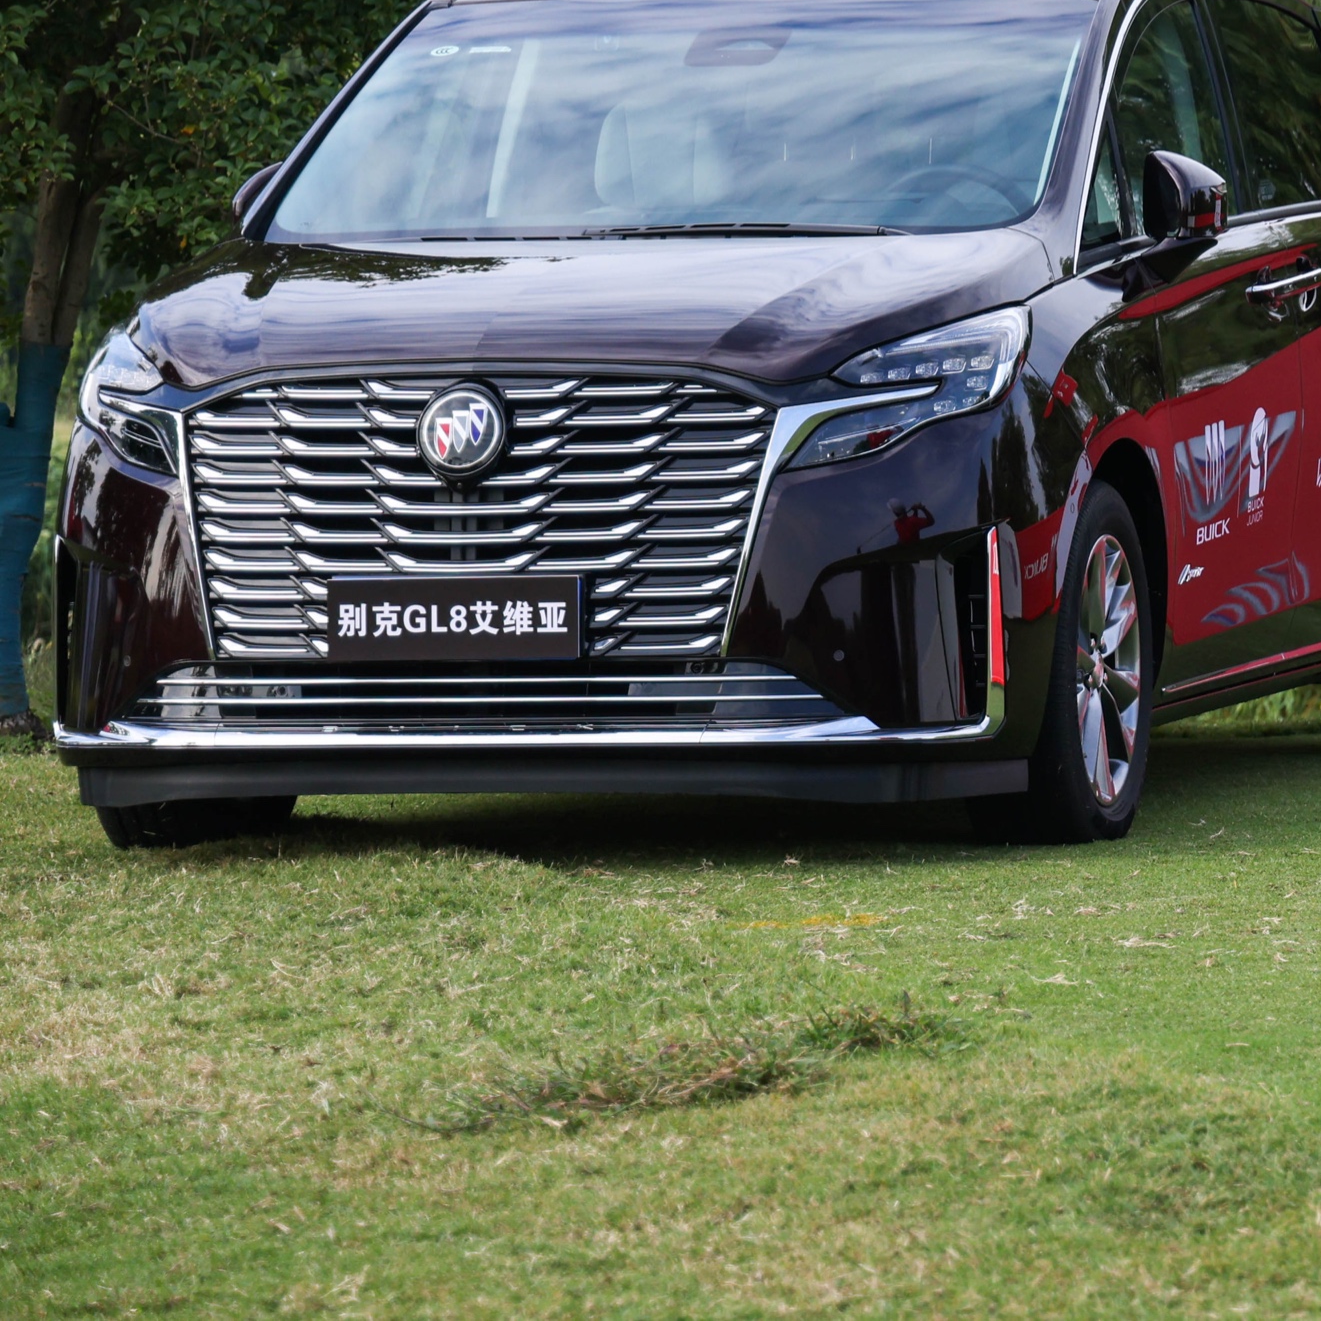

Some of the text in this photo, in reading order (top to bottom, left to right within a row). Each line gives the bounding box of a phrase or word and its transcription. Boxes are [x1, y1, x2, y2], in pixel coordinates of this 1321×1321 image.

[1247, 496, 1265, 513] BUICK
[1196, 517, 1231, 545] BUICK
[337, 600, 568, 637] 别克GL8艾维亚
